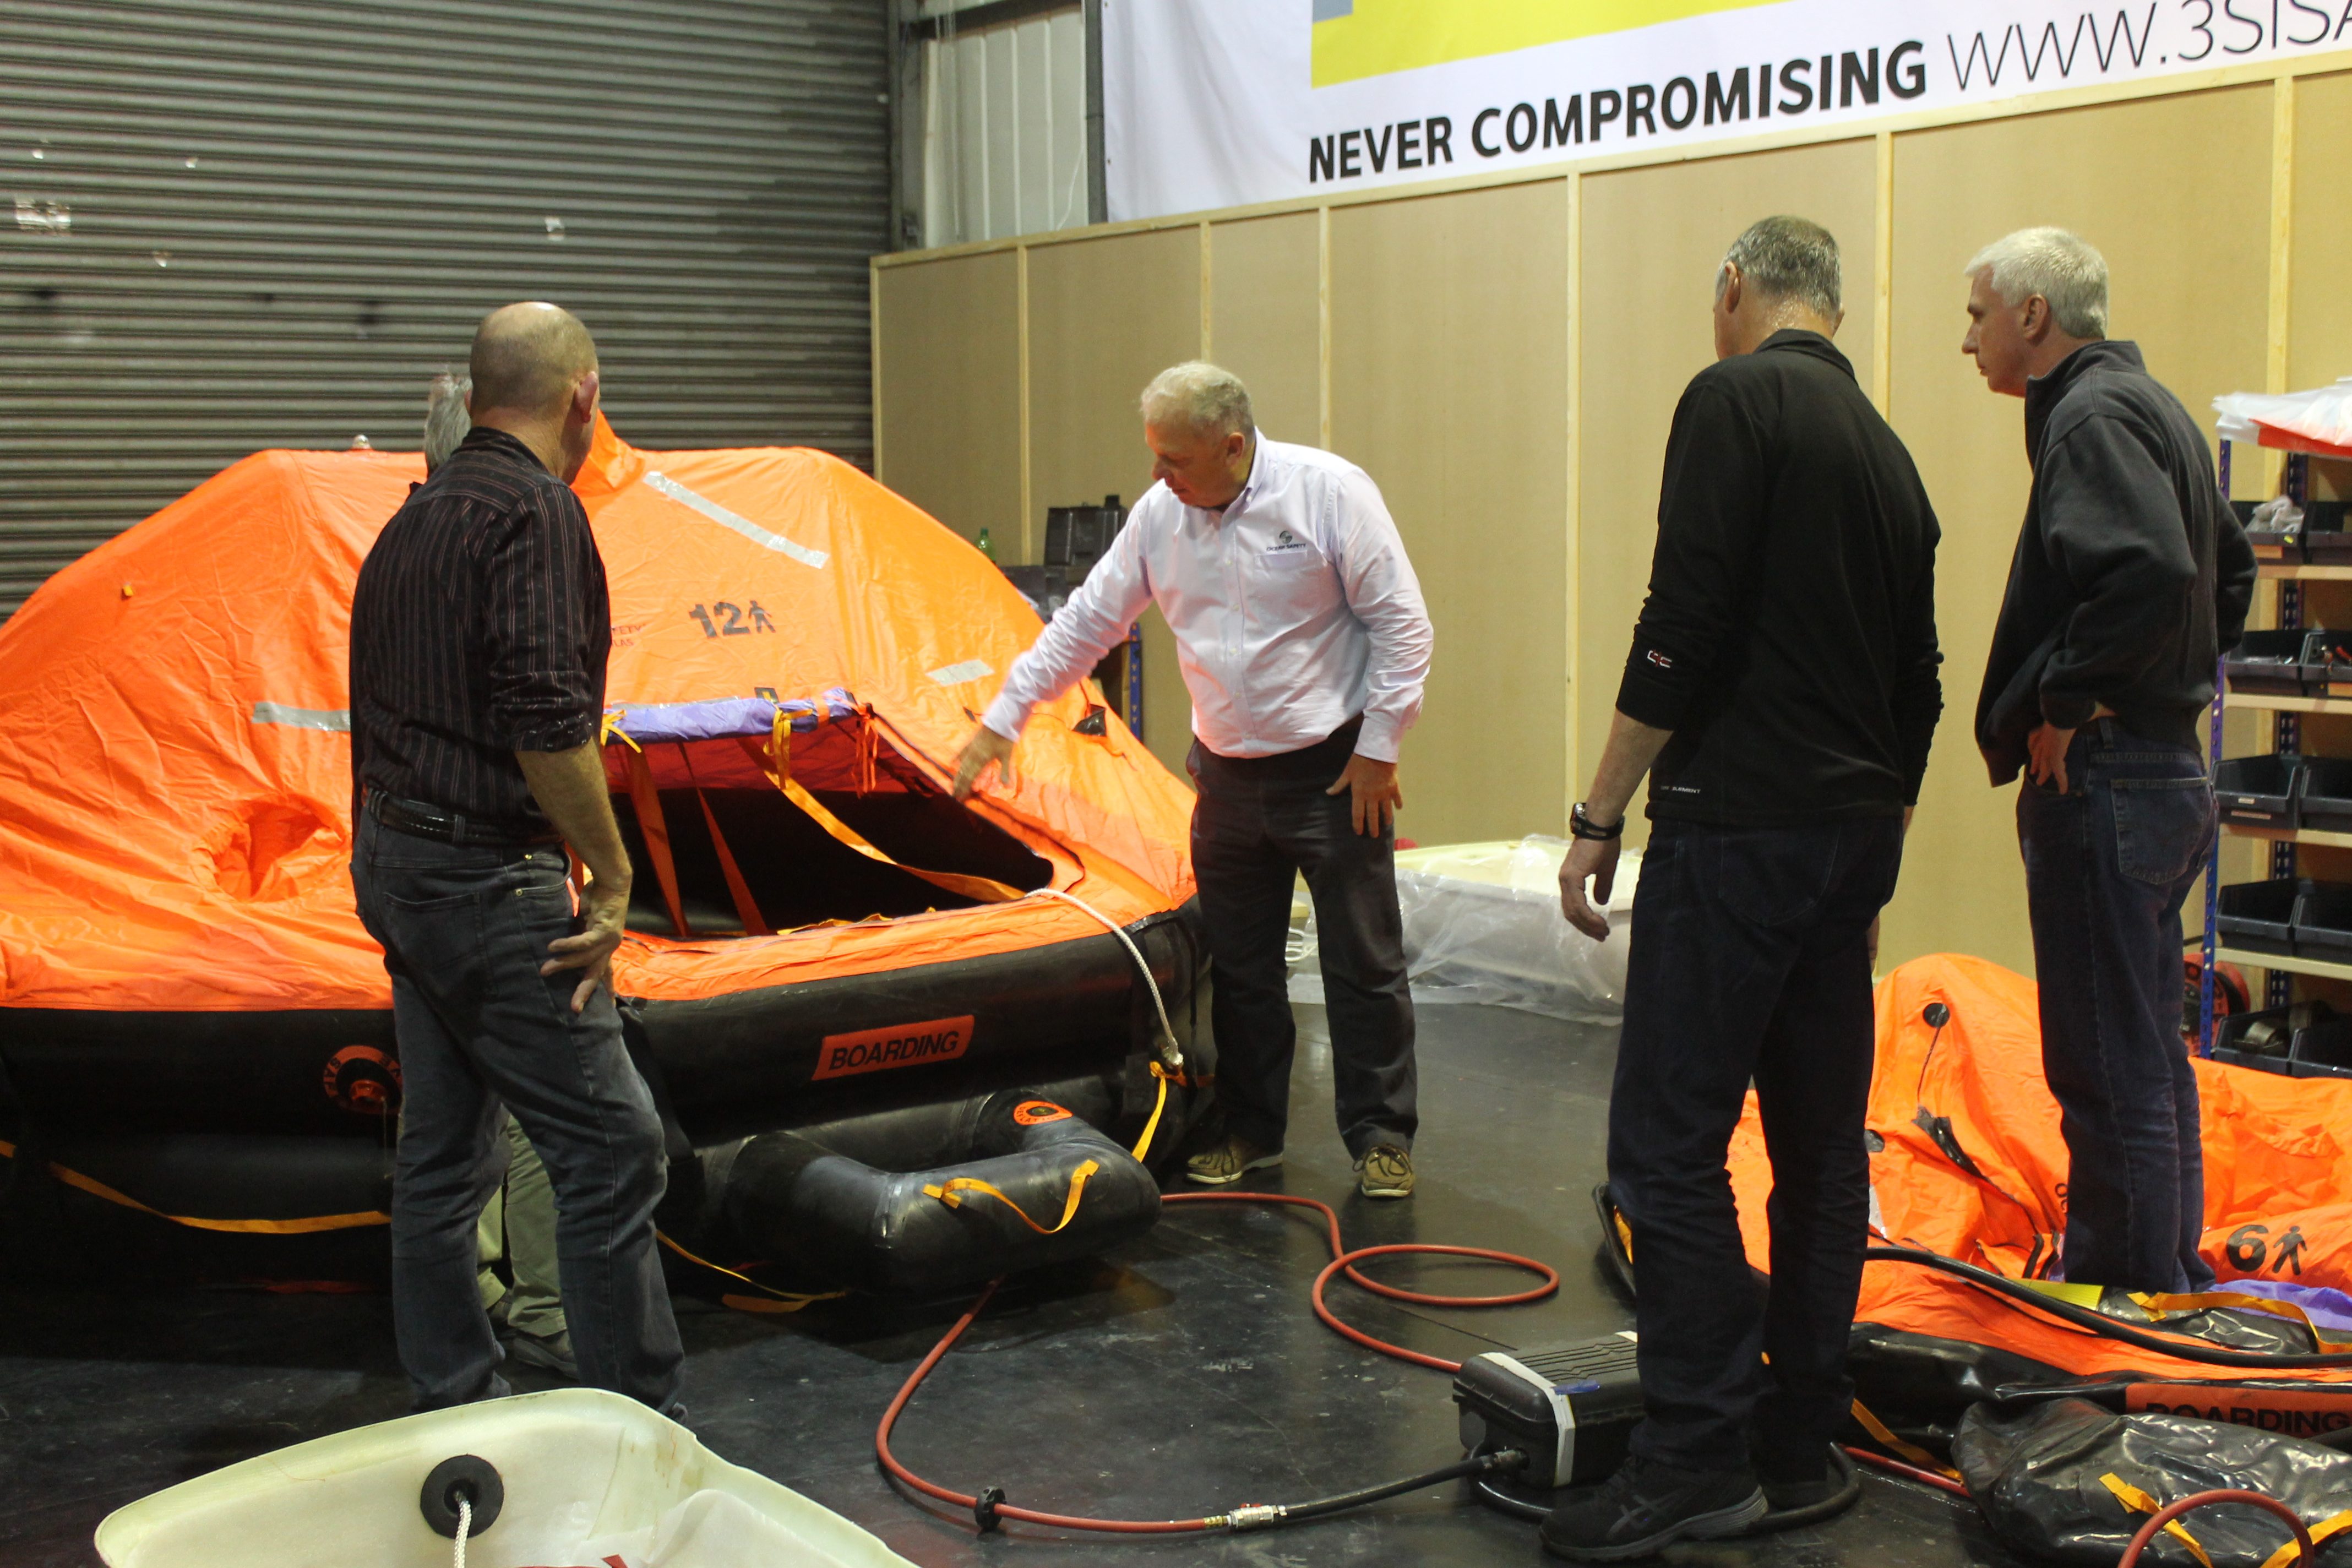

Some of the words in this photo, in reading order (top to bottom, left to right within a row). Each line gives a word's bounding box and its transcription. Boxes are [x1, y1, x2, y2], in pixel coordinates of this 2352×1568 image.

[1309, 117, 1453, 183] NEVER
[1471, 41, 1926, 157] COMPROMISING
[689, 601, 751, 639] 12
[829, 1031, 959, 1070] BOARDING
[2226, 1224, 2269, 1272] 6
